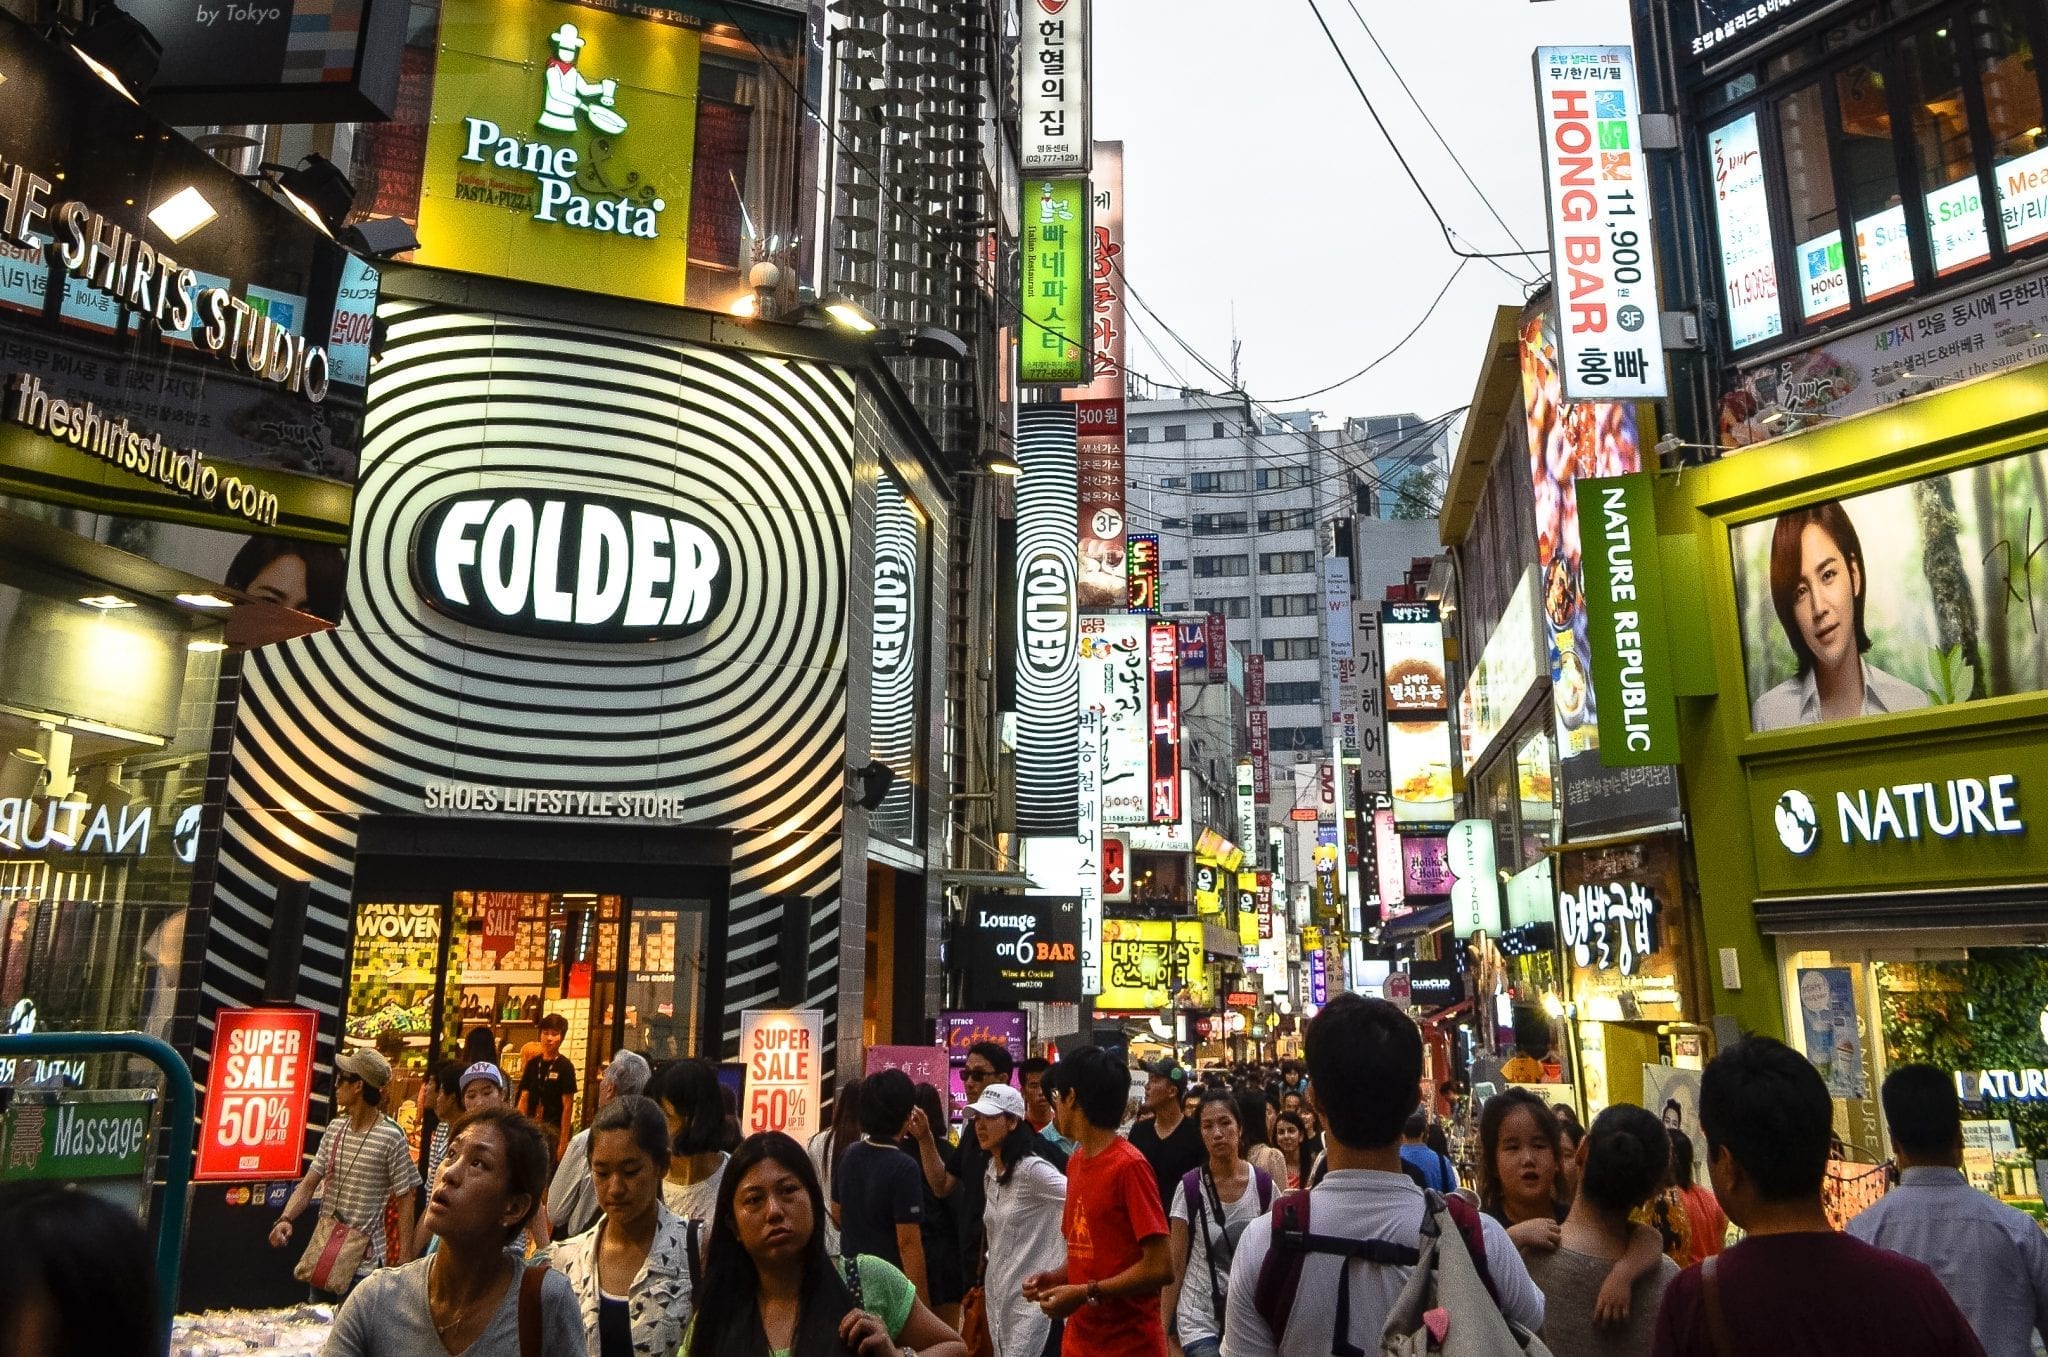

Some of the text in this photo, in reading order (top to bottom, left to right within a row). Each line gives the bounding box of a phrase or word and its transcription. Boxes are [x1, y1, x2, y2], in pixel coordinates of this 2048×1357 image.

[196, 4, 281, 23] by Tokyo
[1038, 20, 1064, 136] 헌혈의 집
[1550, 67, 1622, 80] 무/한/리/필
[461, 117, 578, 178] Pane
[1026, 154, 1078, 163] (02) 777-1291
[533, 176, 661, 239] Pasta
[1551, 90, 1608, 334] HONG BAR
[1027, 256, 1037, 297] Restaurant
[1810, 273, 1843, 296] HONG
[55, 200, 196, 331] SHIRTS
[200, 286, 329, 402] STUDIO
[1041, 225, 1068, 358] 빠네파스타
[1620, 311, 1641, 327] 3F
[1874, 322, 1915, 351] 세가지
[1917, 312, 1947, 339] 맛을
[1952, 293, 1998, 327] 동시에
[1968, 361, 1990, 375] the
[1991, 351, 2024, 370] same
[18, 373, 279, 527] theshirtsstudio com
[1095, 516, 1120, 532] 3F
[434, 497, 721, 626] FOLDER
[1026, 557, 1068, 668] FOLDER
[1602, 487, 1651, 752] NATURE REPUBLIC
[1358, 612, 1381, 756] 두가헤어
[1388, 682, 1444, 701] 멸치우동
[1320, 764, 1335, 804] DVD
[424, 783, 685, 820] SHOES LIFESTYLE STORE
[1836, 774, 2023, 844] NATURE
[1411, 855, 1443, 867] Holika
[1419, 867, 1450, 878] Holika
[979, 910, 1036, 931] Lounge
[1062, 902, 1074, 912] 6F
[356, 916, 441, 938] WOVEN
[485, 909, 517, 937] SALE
[996, 943, 1014, 956] on
[1036, 942, 1076, 961] BAR
[1001, 969, 1019, 979] Wine
[228, 1028, 302, 1056] SUPER
[753, 1028, 810, 1050] SUPER
[223, 1056, 298, 1090] SALE
[752, 1052, 809, 1081] SALE
[1954, 1069, 2048, 1098] ATUR
[217, 1096, 291, 1148] 50%
[750, 1088, 807, 1133] 50%
[787, 1117, 806, 1128] UP TO
[53, 1105, 144, 1159] Massage
[264, 1128, 287, 1142] UP TO
[269, 1188, 287, 1199] ADT
